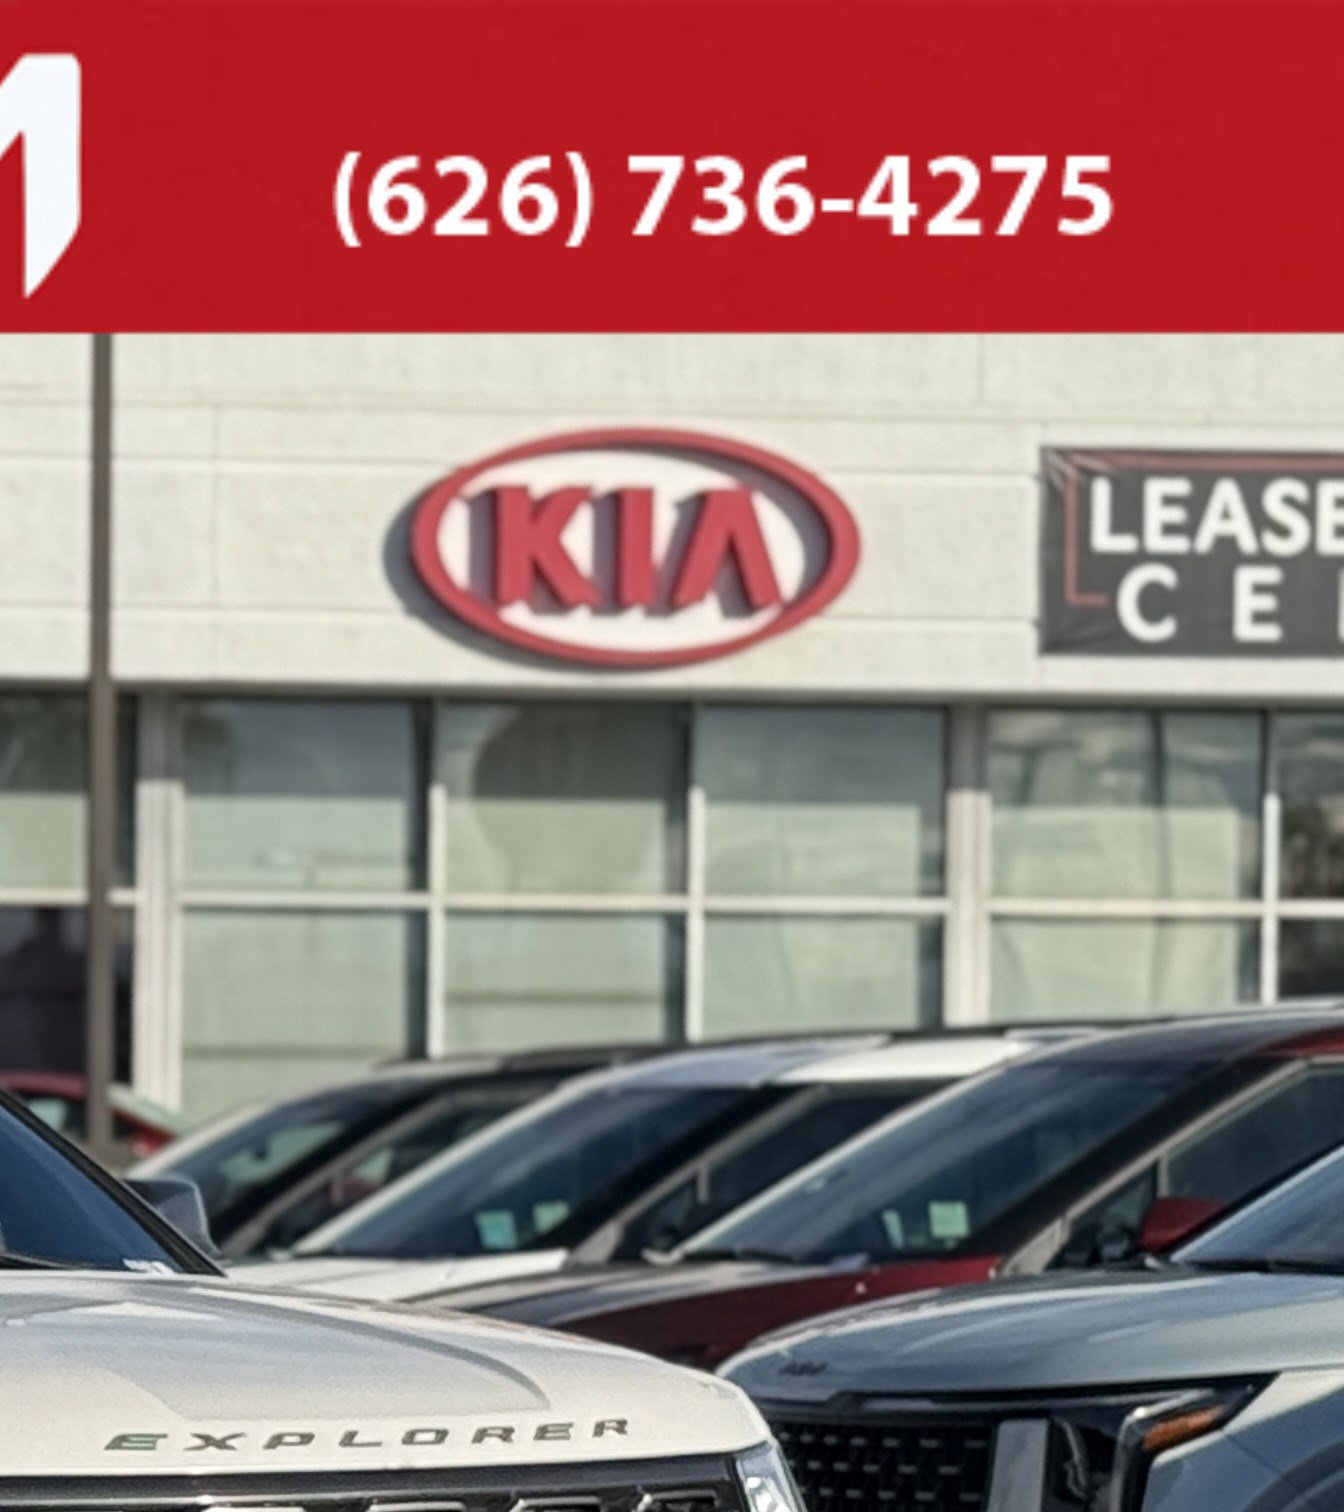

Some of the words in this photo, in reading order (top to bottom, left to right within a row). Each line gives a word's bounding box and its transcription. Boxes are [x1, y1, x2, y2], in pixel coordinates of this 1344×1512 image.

[492, 484, 785, 610] KIA
[1090, 476, 1344, 556] LEASE
[104, 1418, 628, 1452] EXPLORER
